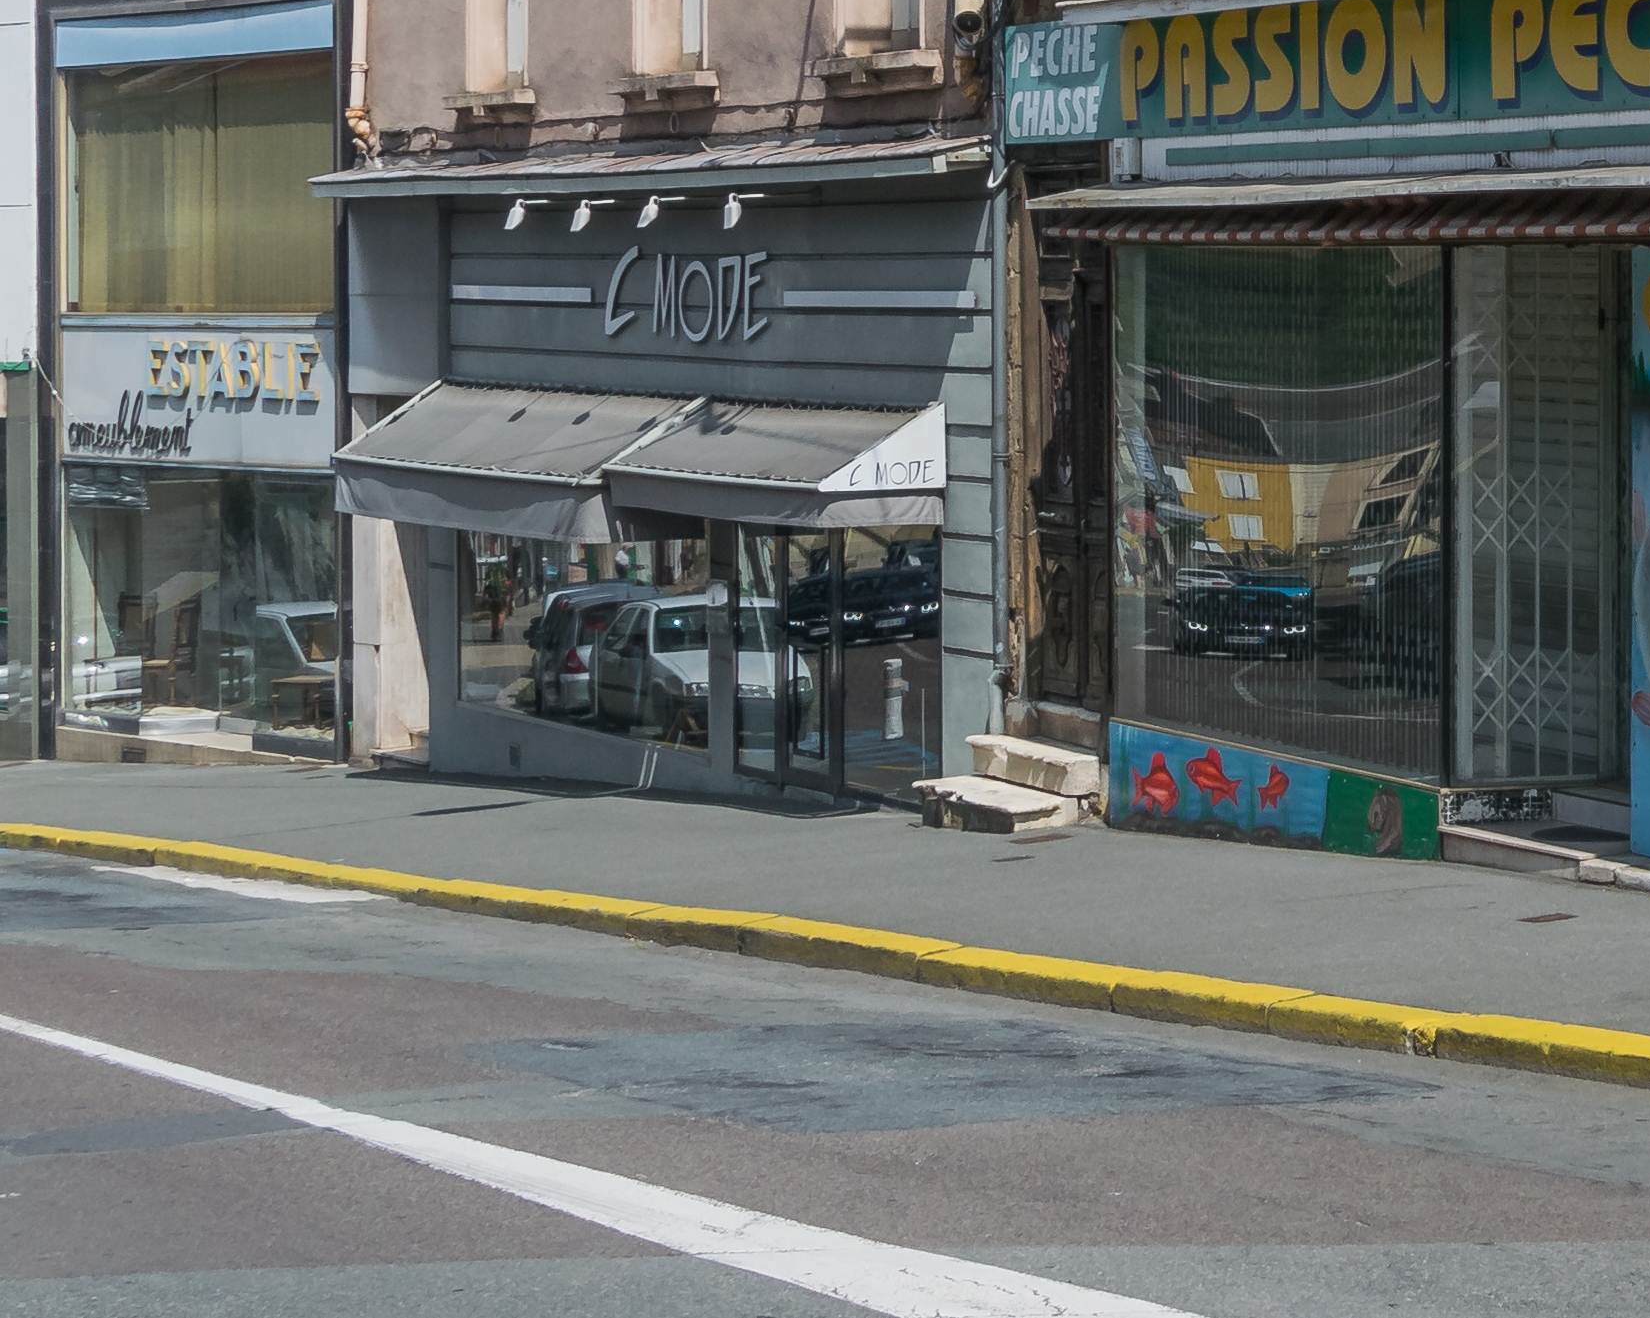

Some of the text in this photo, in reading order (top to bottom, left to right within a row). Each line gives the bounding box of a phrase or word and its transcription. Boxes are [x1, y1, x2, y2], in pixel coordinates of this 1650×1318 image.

[1010, 23, 1098, 79] PECHE
[1008, 85, 1100, 139] CHASSE
[652, 251, 768, 343] MODE
[147, 339, 321, 402] ESTABLIE
[68, 388, 193, 452] ameublement
[874, 458, 936, 486] MODE
